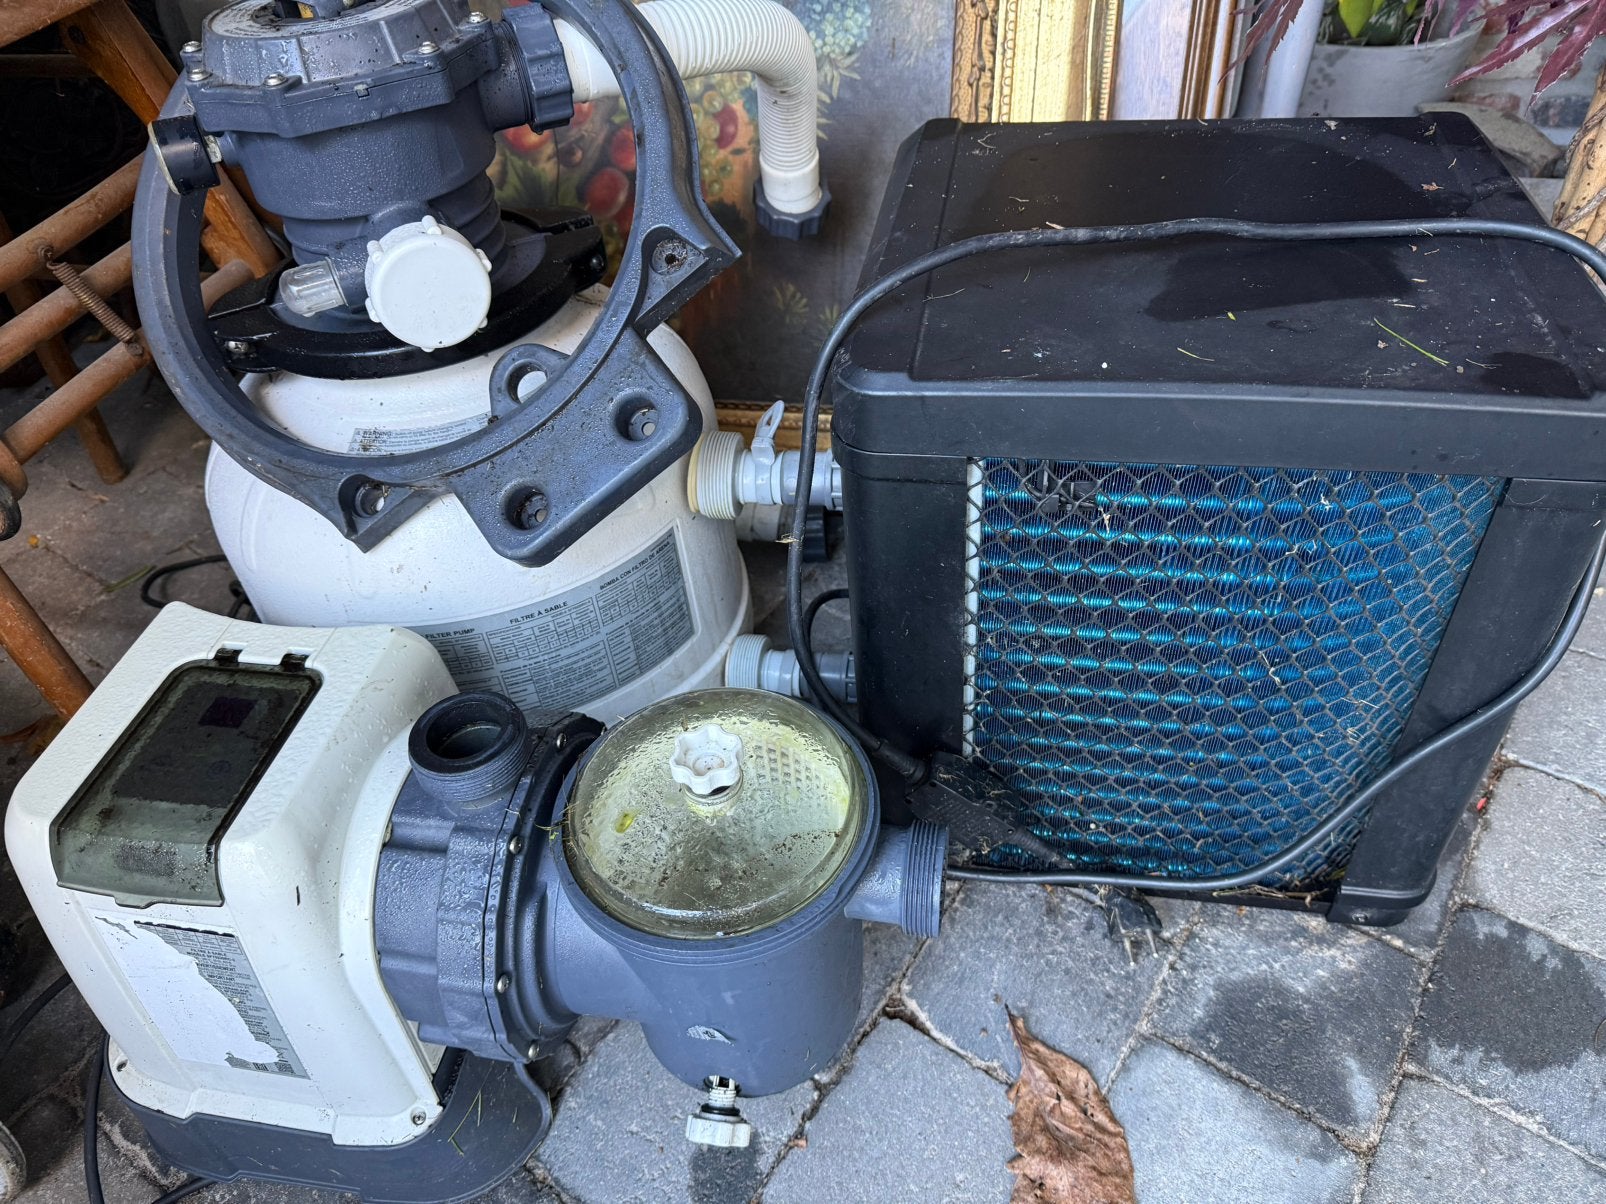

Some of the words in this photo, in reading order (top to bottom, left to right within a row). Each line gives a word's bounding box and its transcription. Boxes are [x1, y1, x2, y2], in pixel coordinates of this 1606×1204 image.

[600, 577, 620, 590] BOMBA
[620, 570, 632, 579] CON
[632, 559, 649, 571] FILTRO
[509, 612, 535, 624] FILTRE
[544, 601, 568, 614] SABLE
[425, 631, 453, 639] FILTER
[453, 628, 475, 636] PUMP
